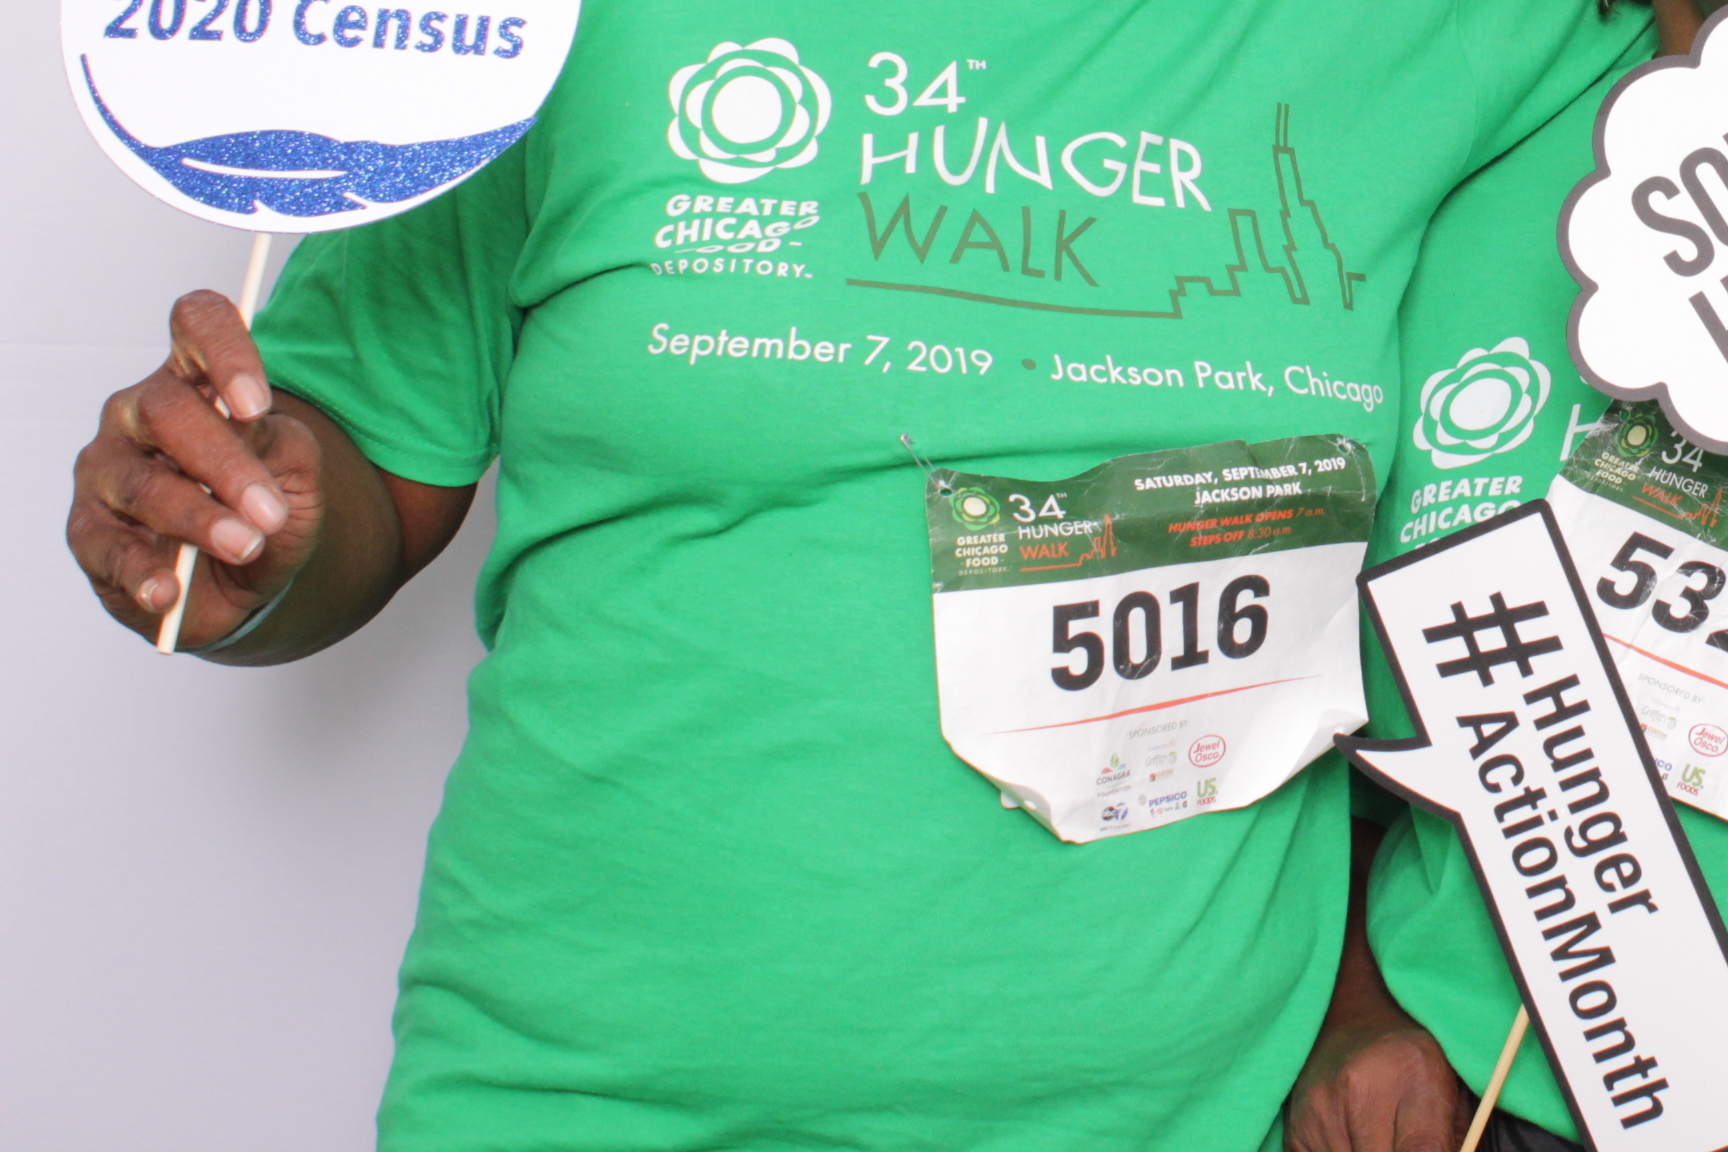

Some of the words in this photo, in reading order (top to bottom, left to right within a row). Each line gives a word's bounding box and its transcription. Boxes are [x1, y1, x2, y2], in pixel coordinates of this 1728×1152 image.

[860, 116, 1213, 212] HUNGER
[665, 194, 820, 217] GREATER
[654, 215, 821, 249] CHICAGO
[856, 191, 1100, 288] WALK
[647, 322, 852, 365] September
[863, 335, 892, 373] 7,
[906, 340, 994, 376] 2019
[1049, 353, 1185, 388] Jackson
[1193, 360, 1274, 398] Park,
[1283, 364, 1384, 413] Chicago
[1661, 431, 1705, 473] 34
[1134, 471, 1219, 491] SATURDAY,
[1222, 464, 1298, 482] SEPTEMBER
[1298, 462, 1313, 477] 7,
[1314, 456, 1346, 473] 2019
[1594, 458, 1637, 481] CHICAGO
[1194, 484, 1263, 505] JACKSON
[1266, 481, 1303, 498] PARK
[1641, 482, 1684, 506] WALK
[1648, 466, 1709, 498] HUNGER
[1410, 475, 1523, 514] GREATER
[1018, 519, 1096, 541] HUNGER
[1168, 518, 1218, 534] HUNGER
[1219, 514, 1254, 527] WALK
[1255, 509, 1294, 522] OPENS
[1296, 507, 1304, 518] 7
[956, 532, 1007, 547] GREATER
[1190, 530, 1222, 547] STEPS
[1223, 529, 1246, 543] OFF
[1247, 526, 1272, 540] 8:30
[955, 544, 1009, 558] CHICAGO
[1018, 541, 1070, 561] WALK
[1051, 575, 1270, 692] 5016
[1637, 672, 1691, 700] SPONSORED
[1128, 721, 1178, 739] SPONSORED
[1695, 727, 1726, 745] Jewel
[1193, 740, 1221, 754] Jewel
[1096, 770, 1132, 785] CONAGRA
[1148, 791, 1188, 808] PEPSICO
[1455, 711, 1670, 1130] ActionMonth
